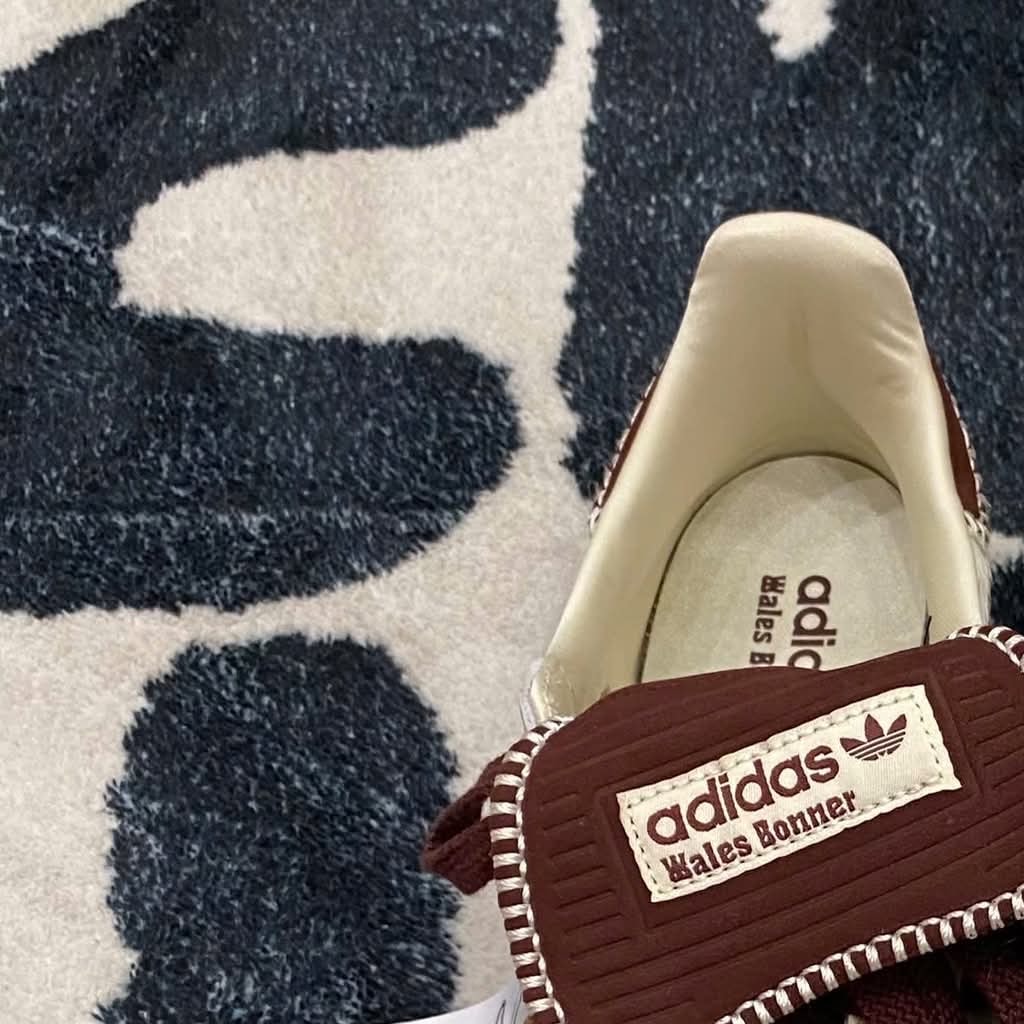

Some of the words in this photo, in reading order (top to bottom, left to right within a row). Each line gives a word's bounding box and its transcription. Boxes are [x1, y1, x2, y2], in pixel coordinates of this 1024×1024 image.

[752, 575, 787, 644] Wales
[646, 744, 840, 846] adidas
[660, 835, 753, 883] Wales
[752, 787, 857, 849] Bonner
